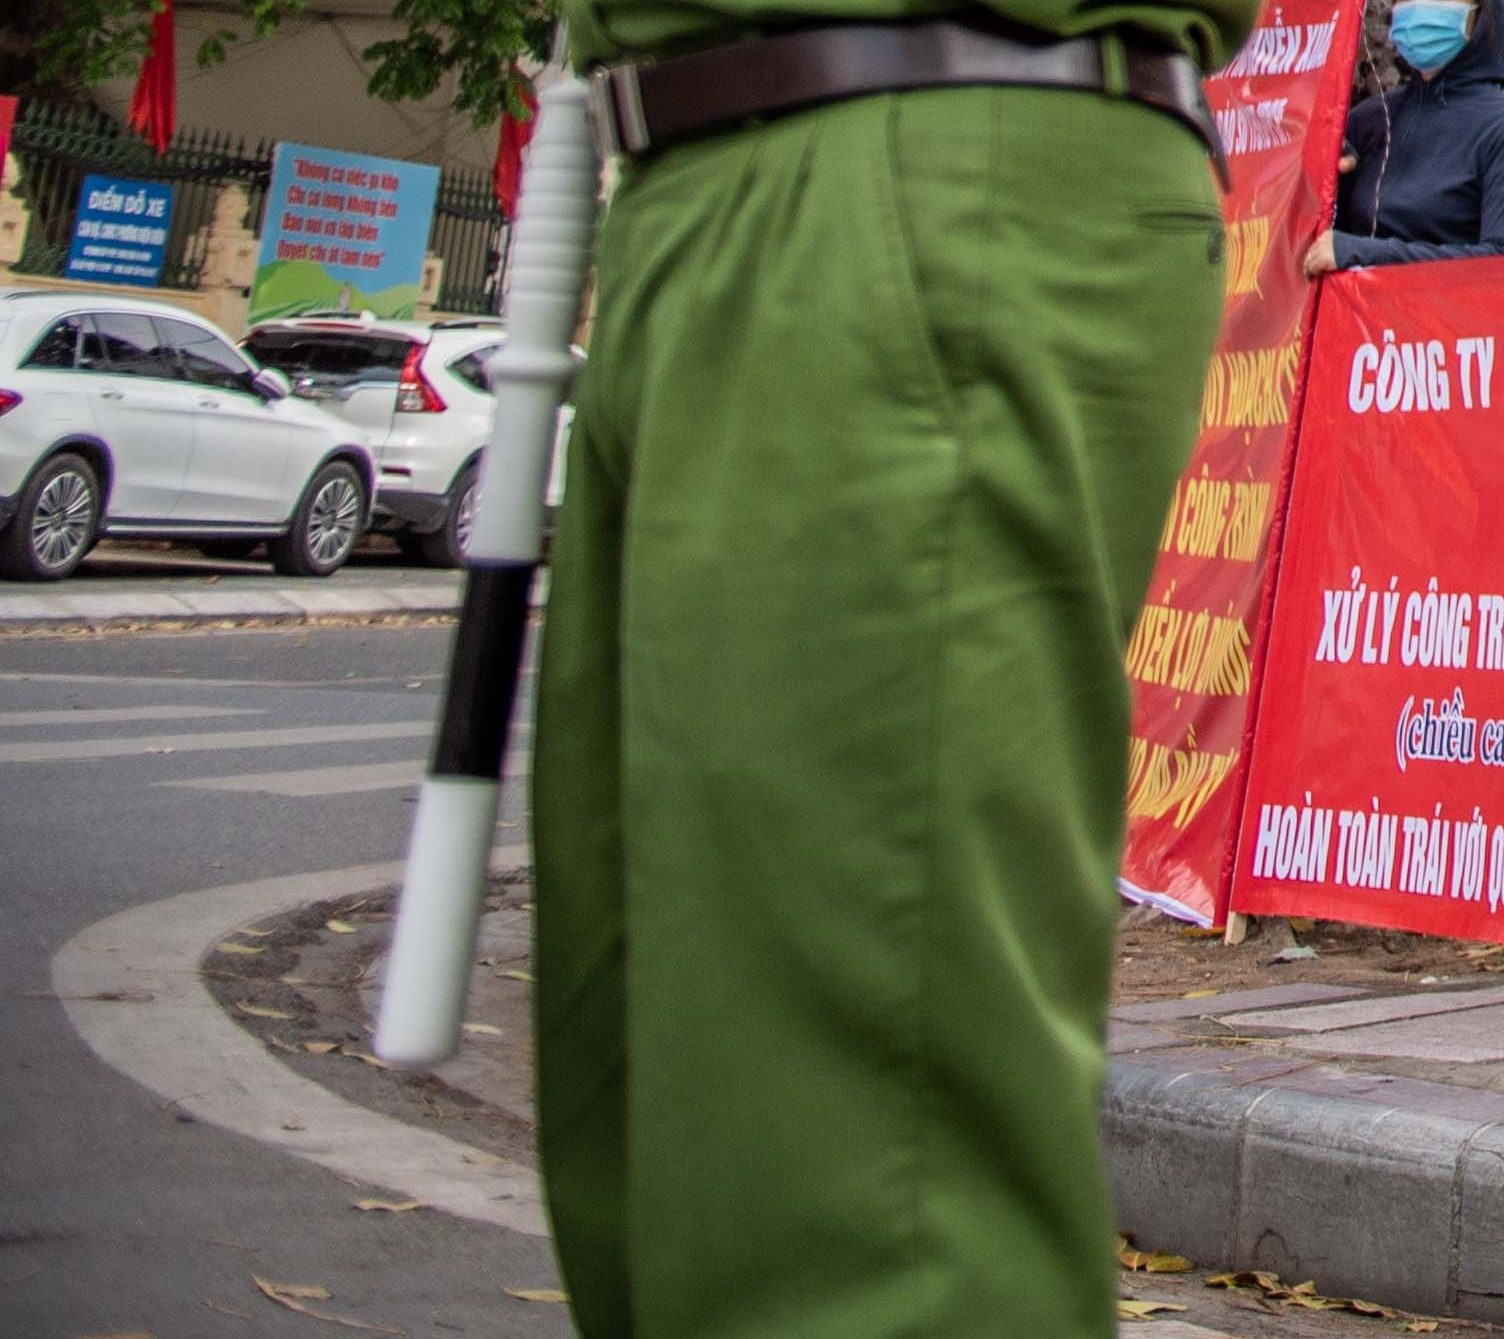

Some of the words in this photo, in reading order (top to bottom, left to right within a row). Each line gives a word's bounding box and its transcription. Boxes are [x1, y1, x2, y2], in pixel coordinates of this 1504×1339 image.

[1349, 329, 1449, 413] CÔNG
[1456, 337, 1494, 408] TY
[1316, 566, 1366, 662] XỬ
[1362, 576, 1400, 663] LÝ
[1402, 577, 1472, 668] CÔNG
[1397, 687, 1476, 771] (chiều
[1254, 791, 1333, 882] HOÀN
[1336, 797, 1398, 889] TOÀN
[1400, 803, 1449, 895] TRÁI
[1452, 807, 1487, 900] VỚI
